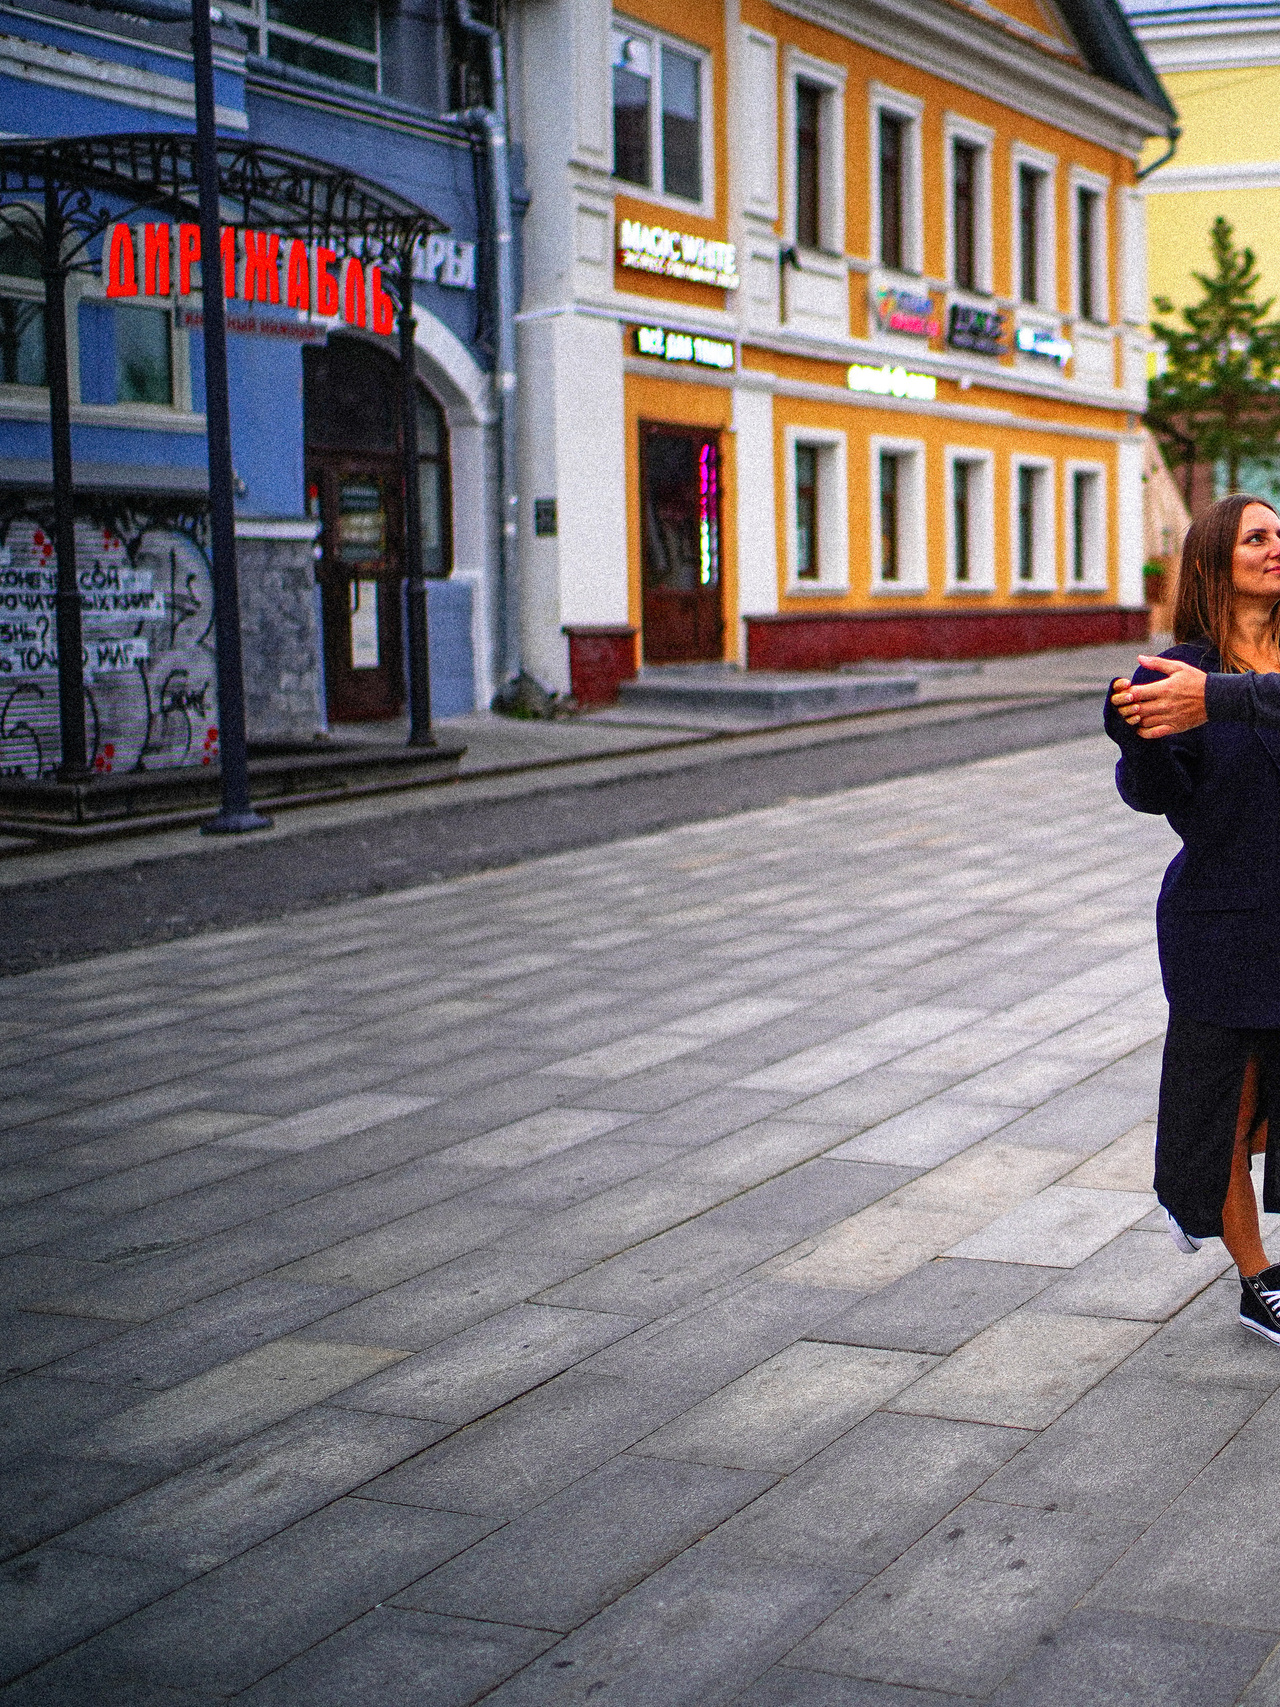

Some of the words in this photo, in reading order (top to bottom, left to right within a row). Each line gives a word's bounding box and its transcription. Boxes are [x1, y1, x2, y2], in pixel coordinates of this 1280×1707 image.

[106, 222, 394, 335] ДИРИЖАБЛЬ
[621, 219, 681, 262] MAGIC
[681, 234, 736, 274] WHITE
